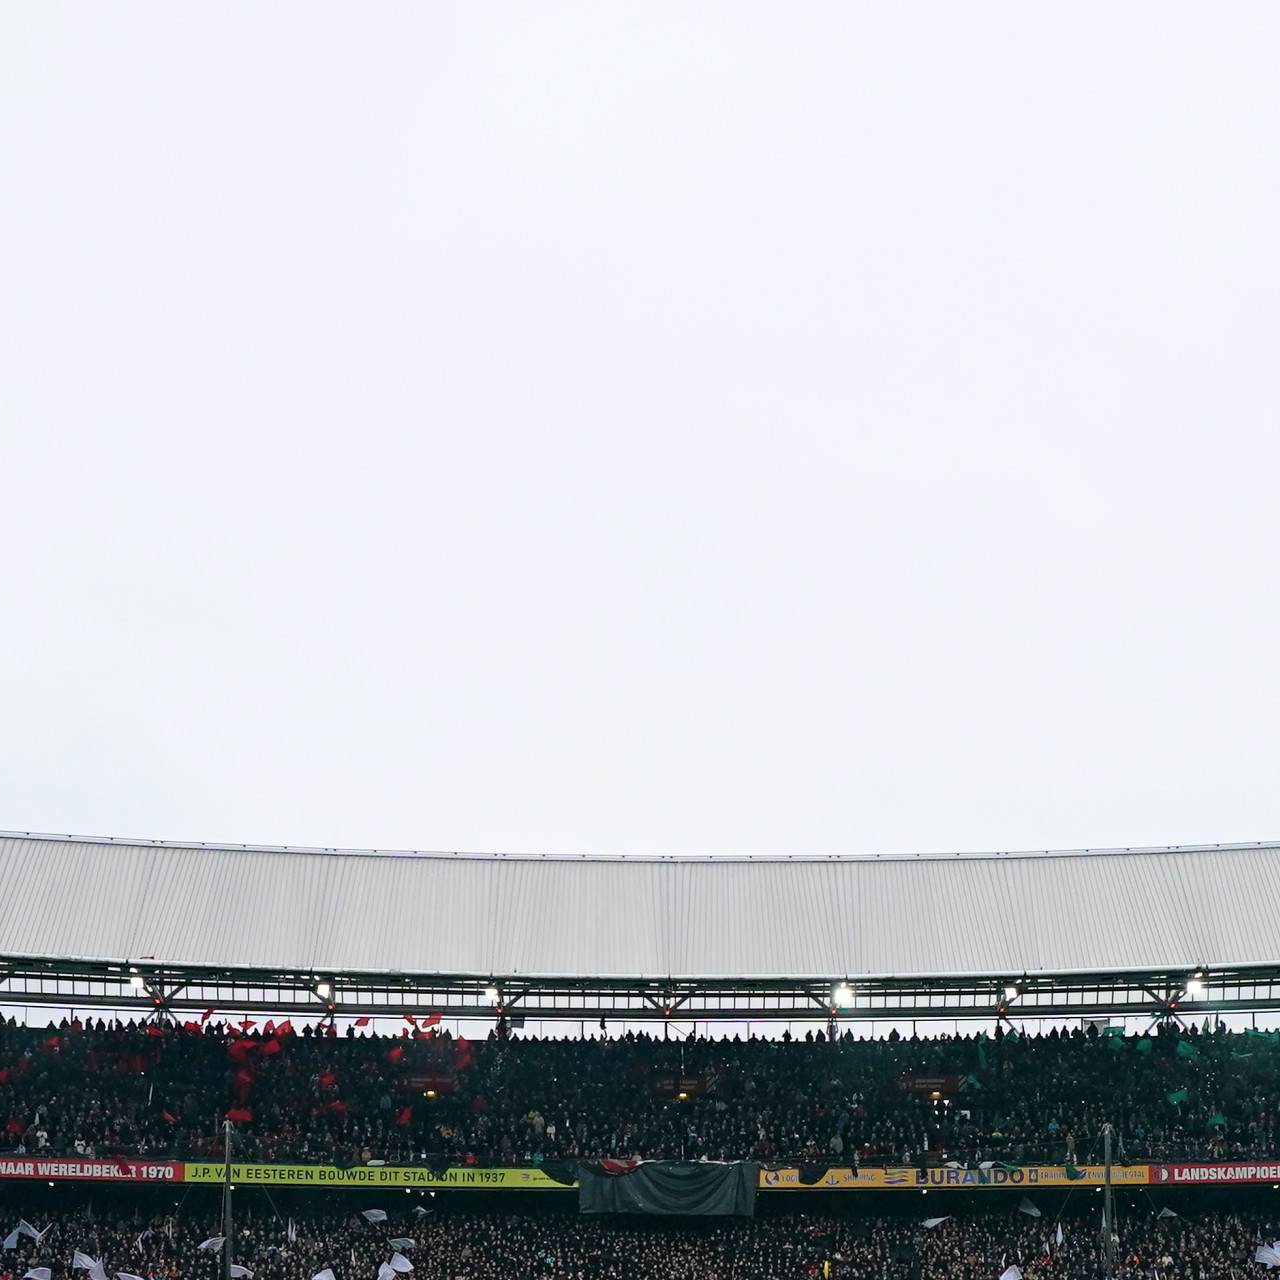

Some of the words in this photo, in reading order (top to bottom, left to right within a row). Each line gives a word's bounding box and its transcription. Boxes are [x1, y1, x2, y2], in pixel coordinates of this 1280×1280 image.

[37, 1163, 136, 1179] WERELDBEKR
[140, 1166, 174, 1179] 1970
[191, 1167, 212, 1178] J.P.
[246, 1168, 314, 1180] EESTEREN
[319, 1169, 375, 1181] BOUWDE
[379, 1171, 400, 1182] DIT
[403, 1171, 458, 1183] STADON
[462, 1172, 475, 1183] IN
[478, 1172, 506, 1183] 1937
